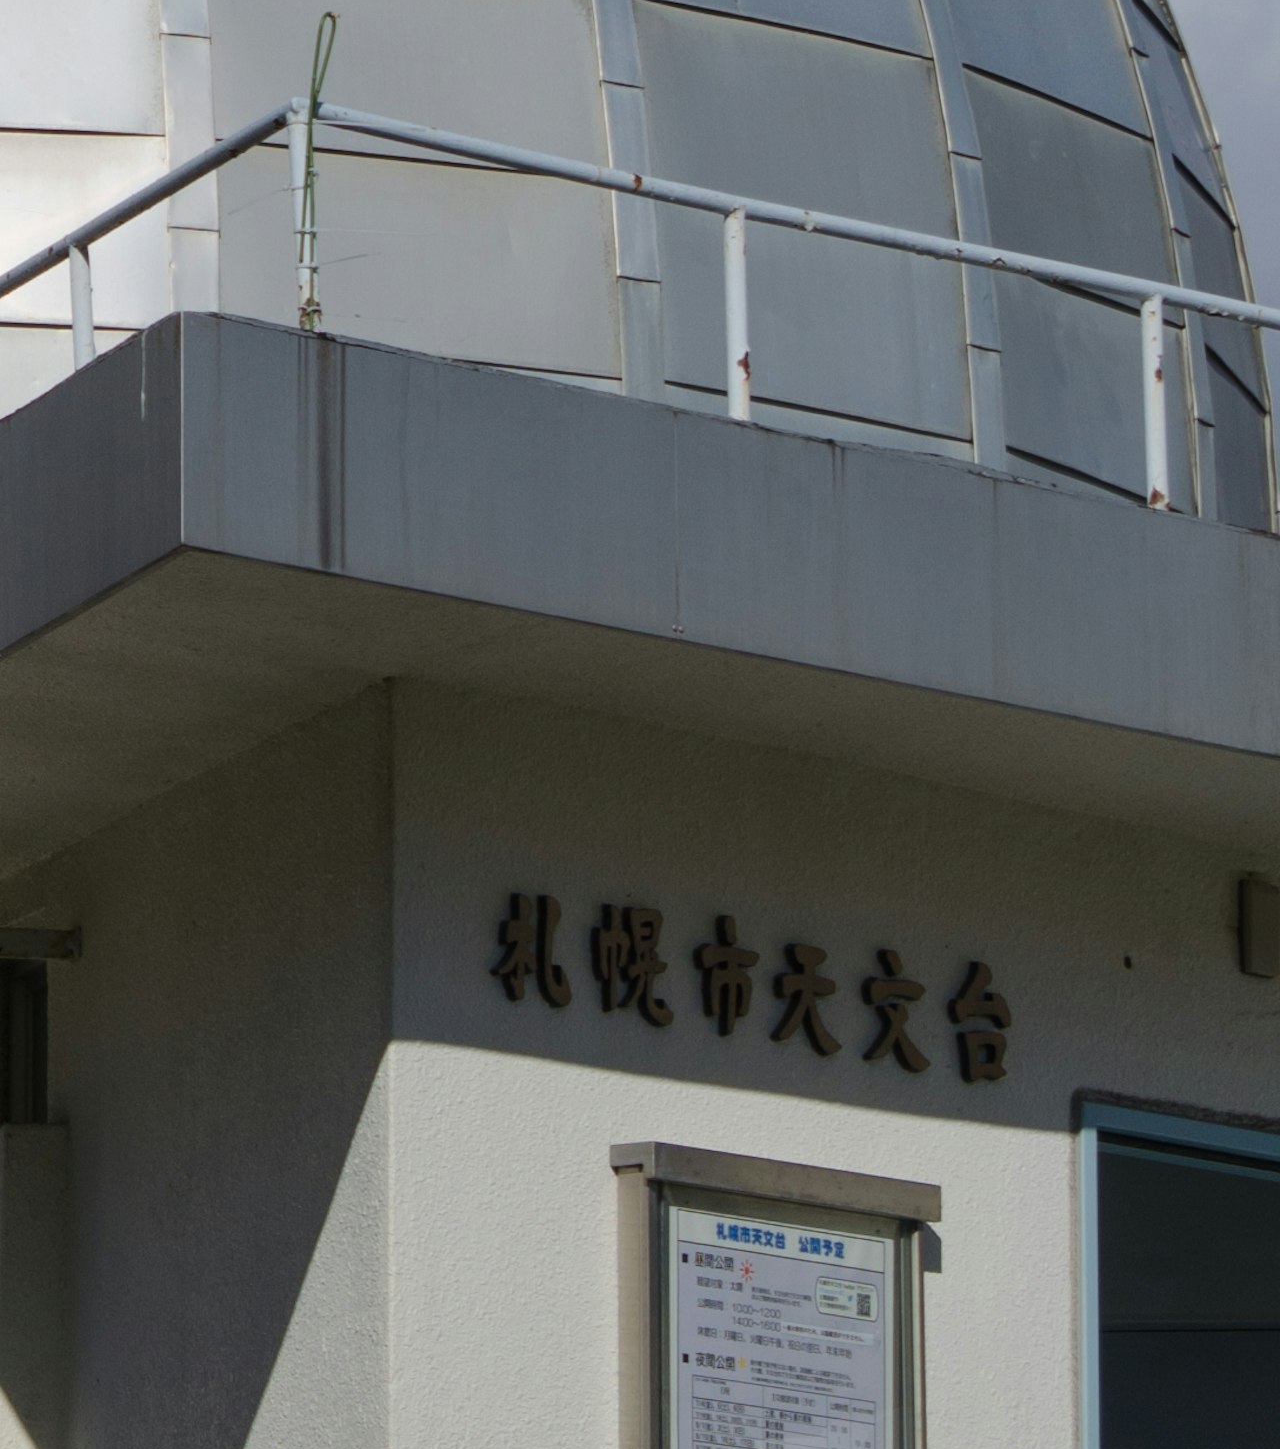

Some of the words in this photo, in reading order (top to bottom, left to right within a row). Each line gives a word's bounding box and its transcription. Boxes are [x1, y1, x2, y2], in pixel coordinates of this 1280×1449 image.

[490, 892, 1012, 1084] 札幌市天文台
[716, 1222, 786, 1250] 札幌市天文台
[798, 1235, 845, 1259] 公開予定
